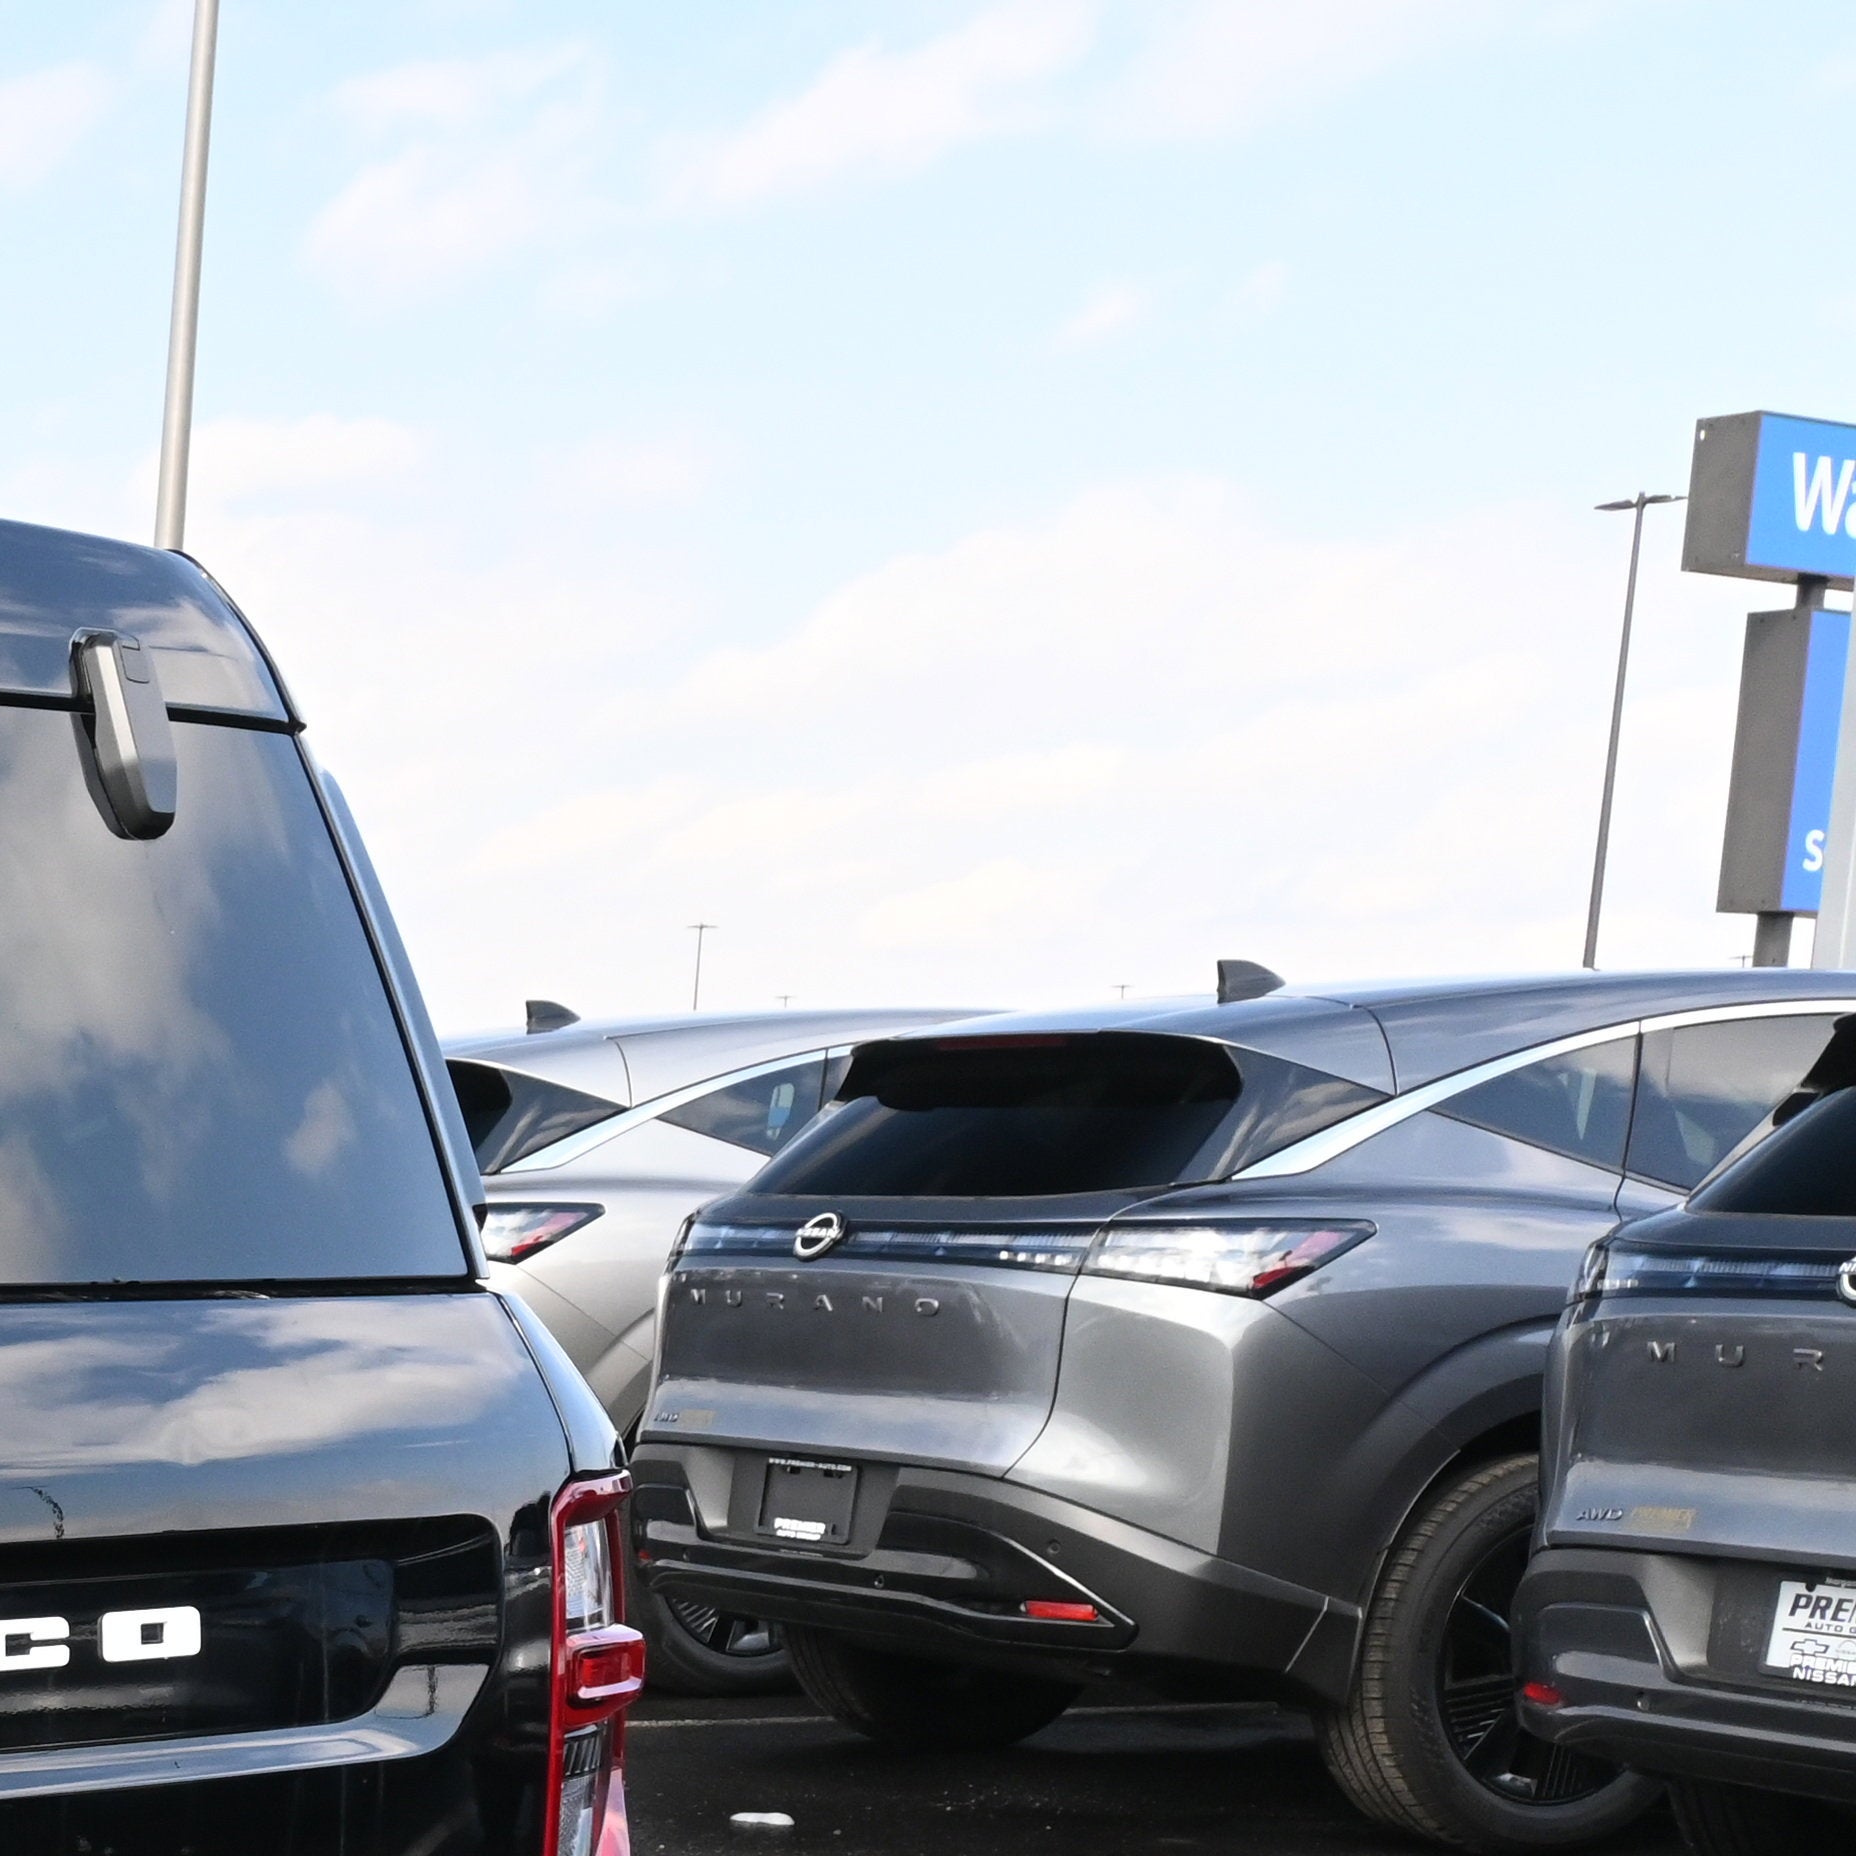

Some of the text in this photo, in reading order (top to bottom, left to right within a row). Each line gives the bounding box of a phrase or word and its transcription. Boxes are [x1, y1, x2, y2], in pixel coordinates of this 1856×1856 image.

[690, 1288, 939, 1316] MURANO
[1576, 1507, 1624, 1521] AWD
[1804, 1621, 1844, 1633] AUTO
